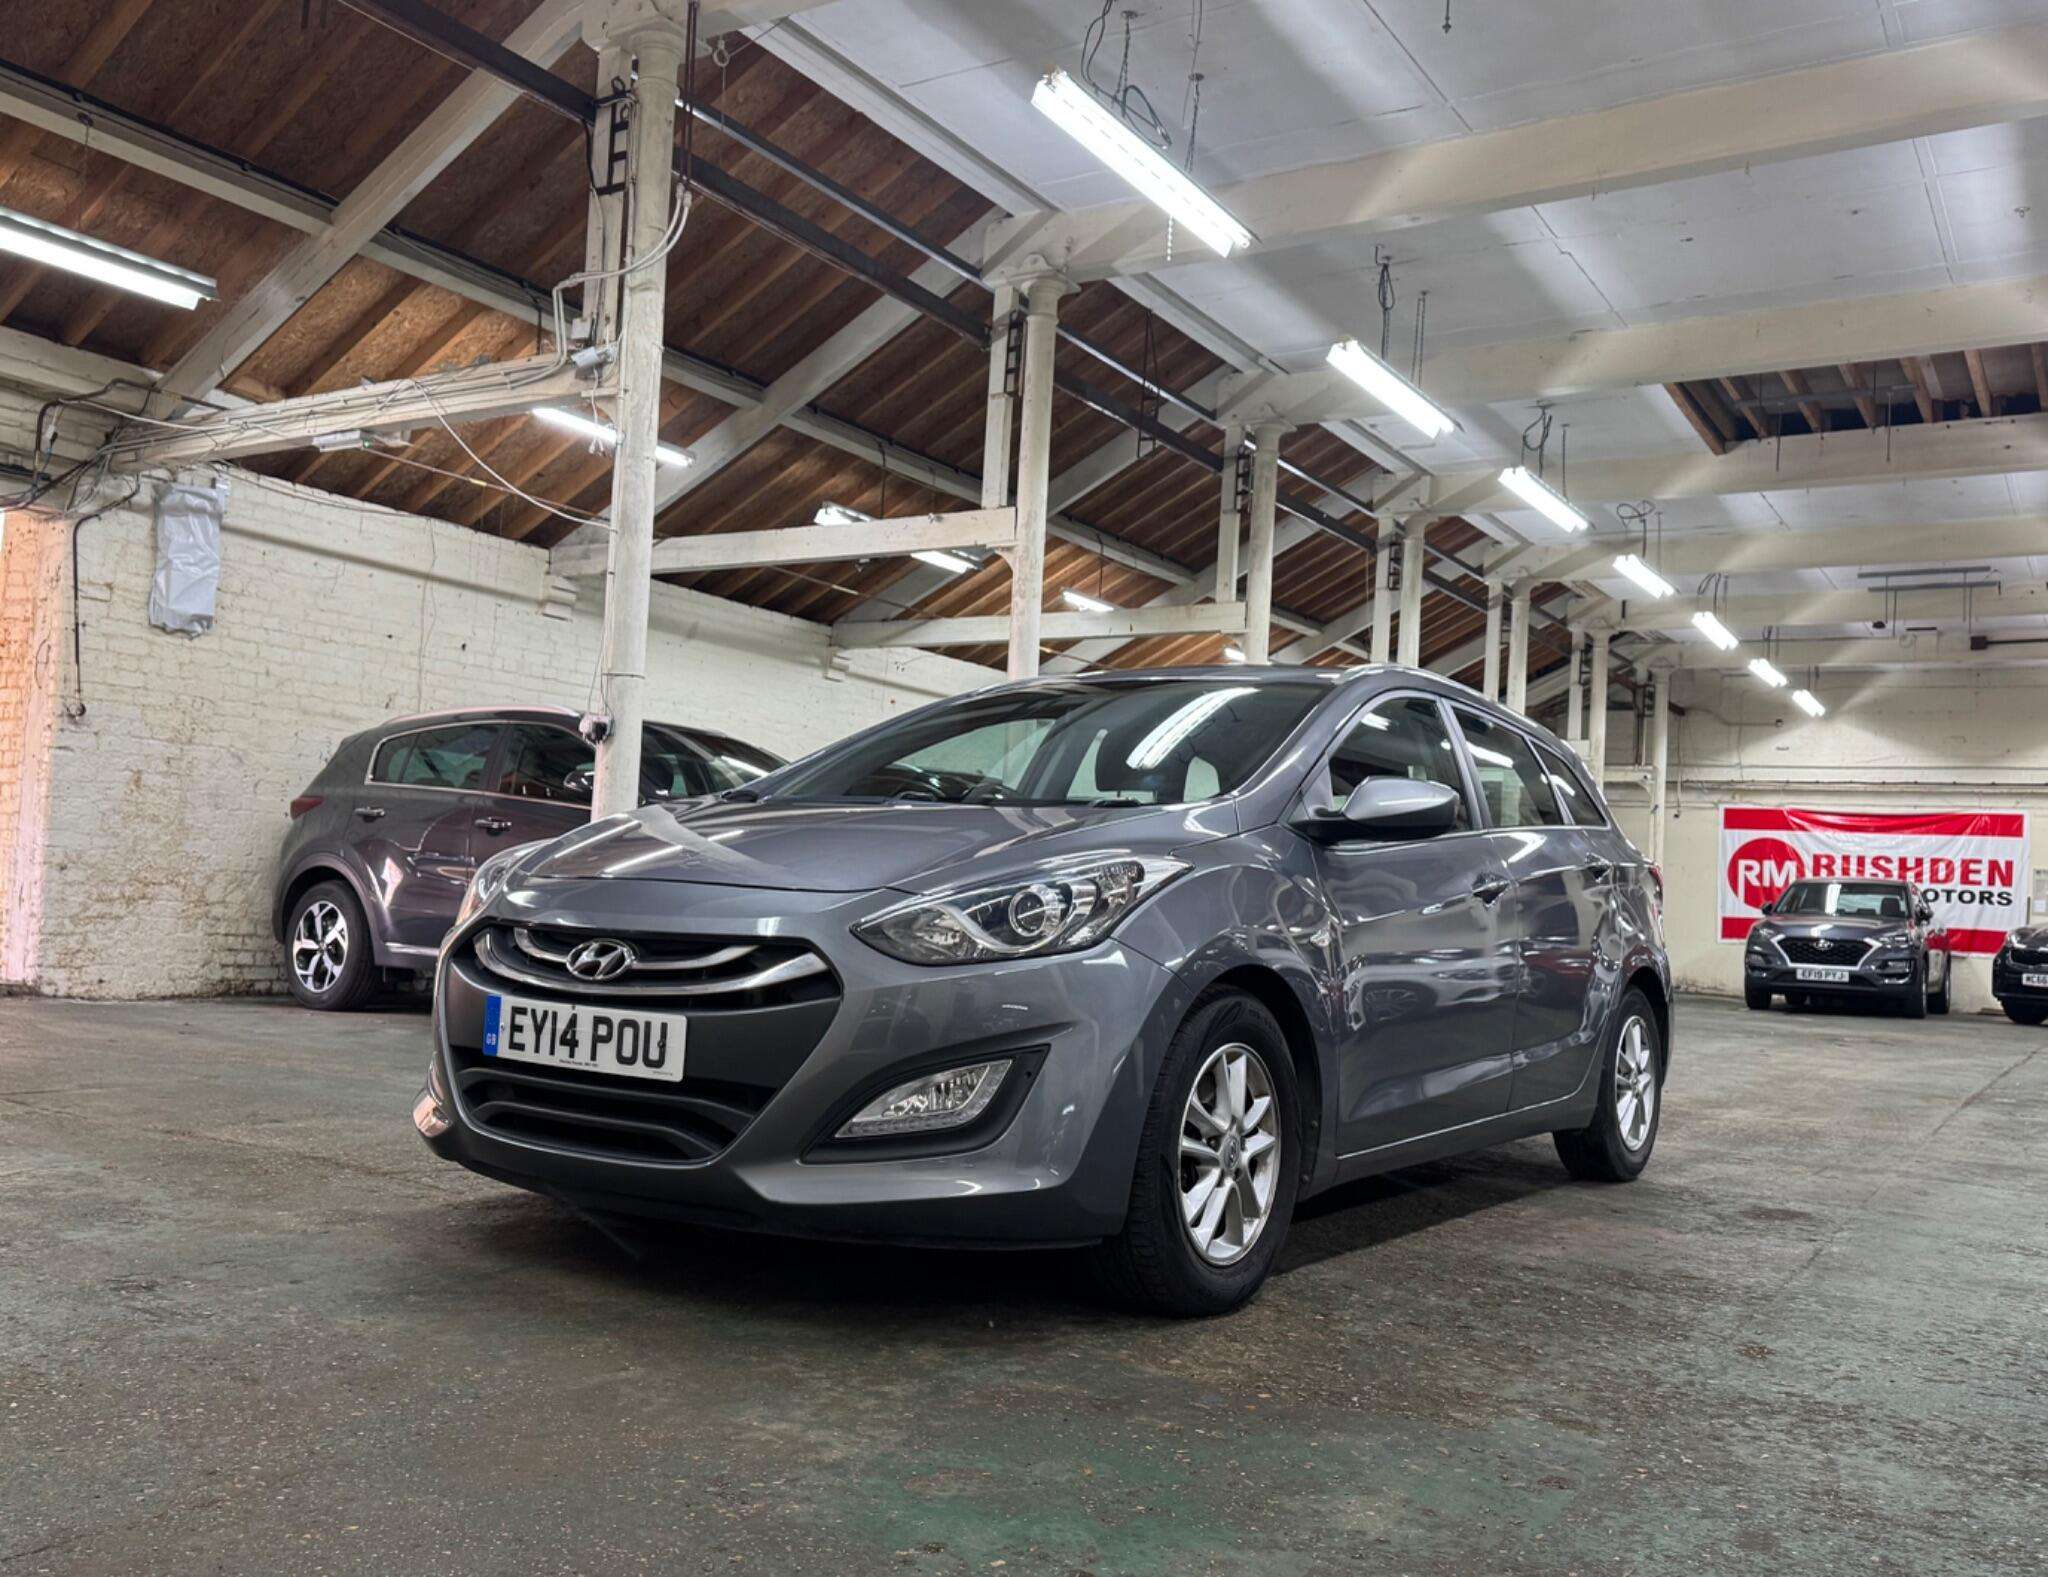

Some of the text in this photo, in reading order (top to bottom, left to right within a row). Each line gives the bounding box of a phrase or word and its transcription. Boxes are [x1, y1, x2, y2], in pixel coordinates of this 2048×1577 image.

[1738, 859, 1797, 899] RM
[1812, 853, 2014, 887] RUSHDEN
[1920, 888, 2013, 906] OTORS
[508, 1005, 668, 1069] EY14 POU
